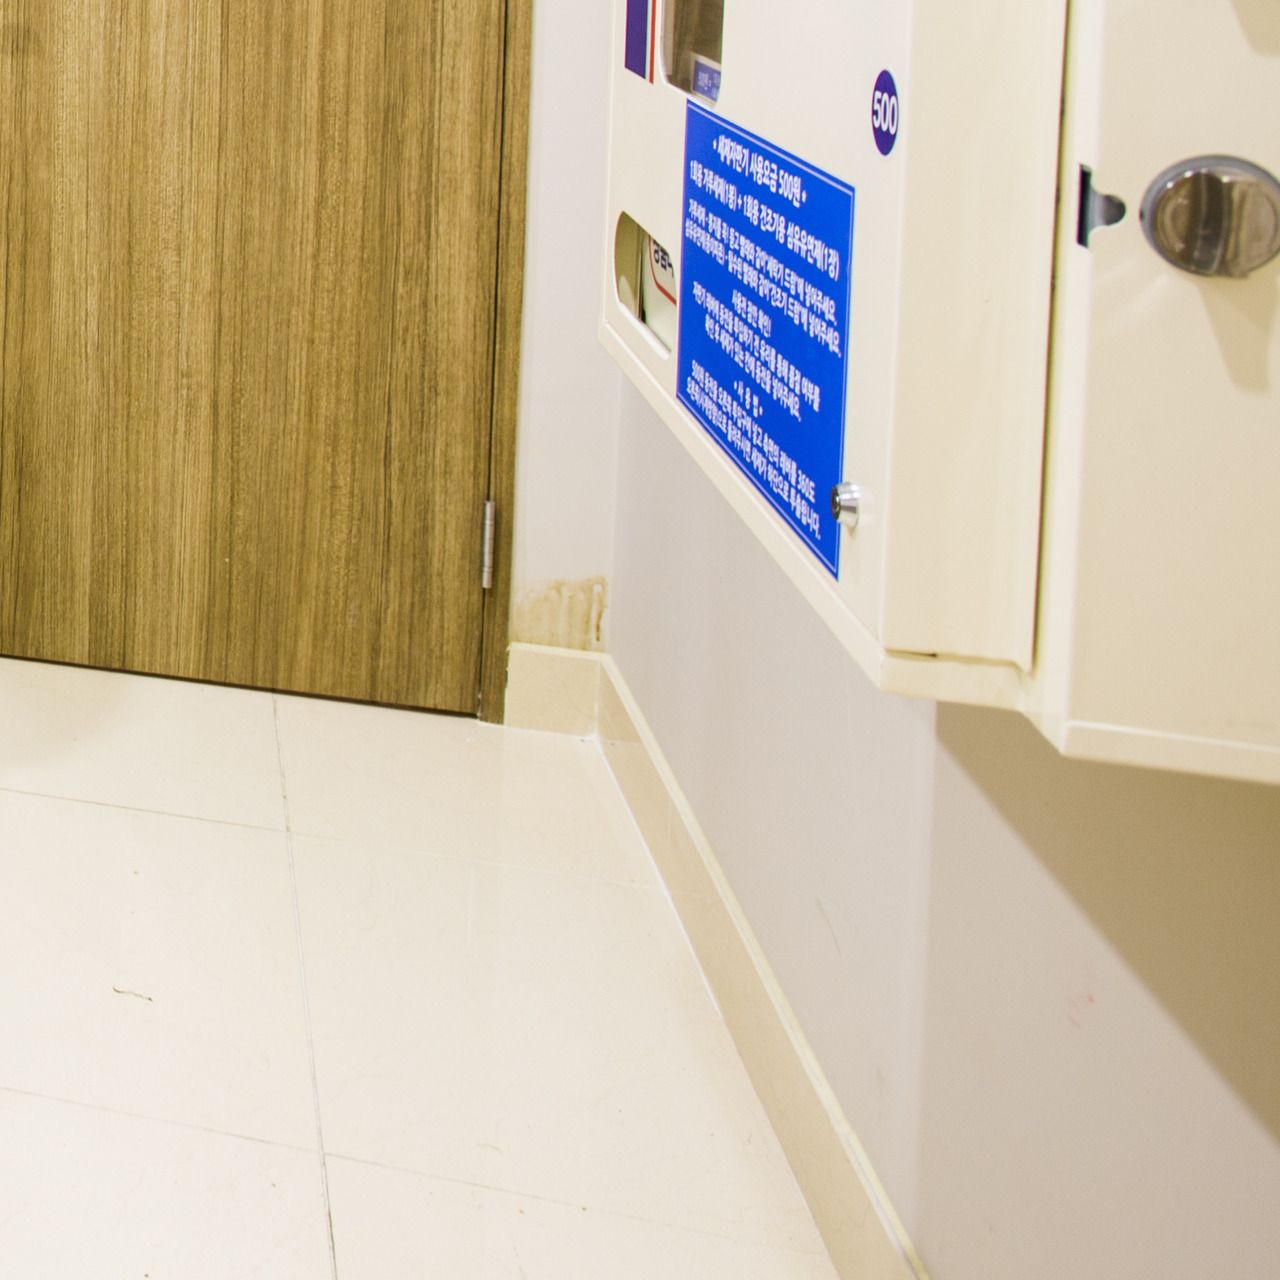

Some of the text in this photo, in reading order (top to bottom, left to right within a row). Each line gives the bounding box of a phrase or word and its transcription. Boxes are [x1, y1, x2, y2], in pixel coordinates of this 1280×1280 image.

[873, 90, 899, 135] 500
[749, 152, 778, 193] 사용요금
[778, 168, 800, 206] 500원
[690, 159, 703, 187] 1회용
[743, 193, 759, 225] 1회용
[759, 203, 786, 244] 건조기용
[786, 220, 839, 280] 섬유유연제(1장)
